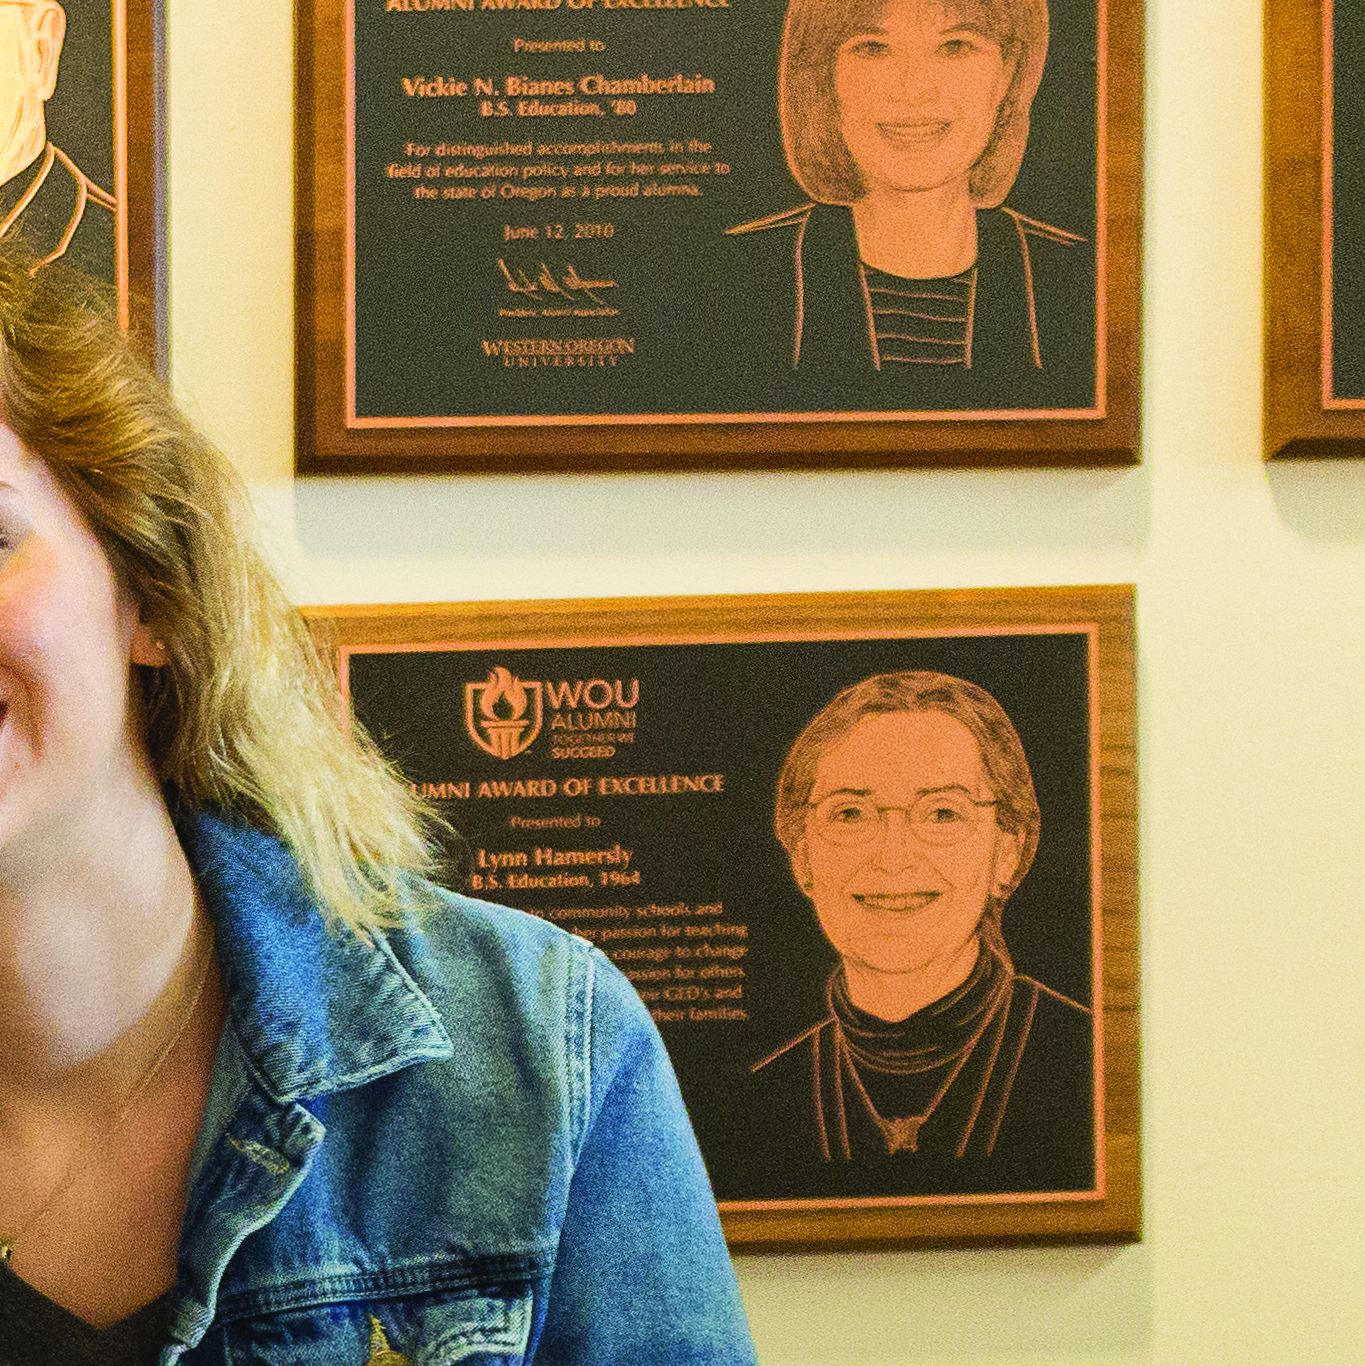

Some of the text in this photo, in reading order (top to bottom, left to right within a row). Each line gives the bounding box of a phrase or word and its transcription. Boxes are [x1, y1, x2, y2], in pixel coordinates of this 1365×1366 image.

[513, 38, 606, 53] Presented to
[401, 73, 715, 97] Vickie N. Bianes Chamberlain
[480, 101, 513, 117] B.S.
[517, 100, 605, 117] Education,
[504, 225, 539, 241] June
[574, 223, 615, 239] 2010
[503, 355, 619, 367] UNIVERSITY
[546, 678, 639, 709] WOU
[551, 712, 636, 730] ALUMNI
[551, 745, 616, 759] SUCCEED
[478, 774, 725, 798] AWARD OF EXCELLENCE
[510, 815, 601, 829] Presented to
[478, 844, 633, 872] Lynn Hamersly
[472, 870, 640, 891] B.S. Education, 1964
